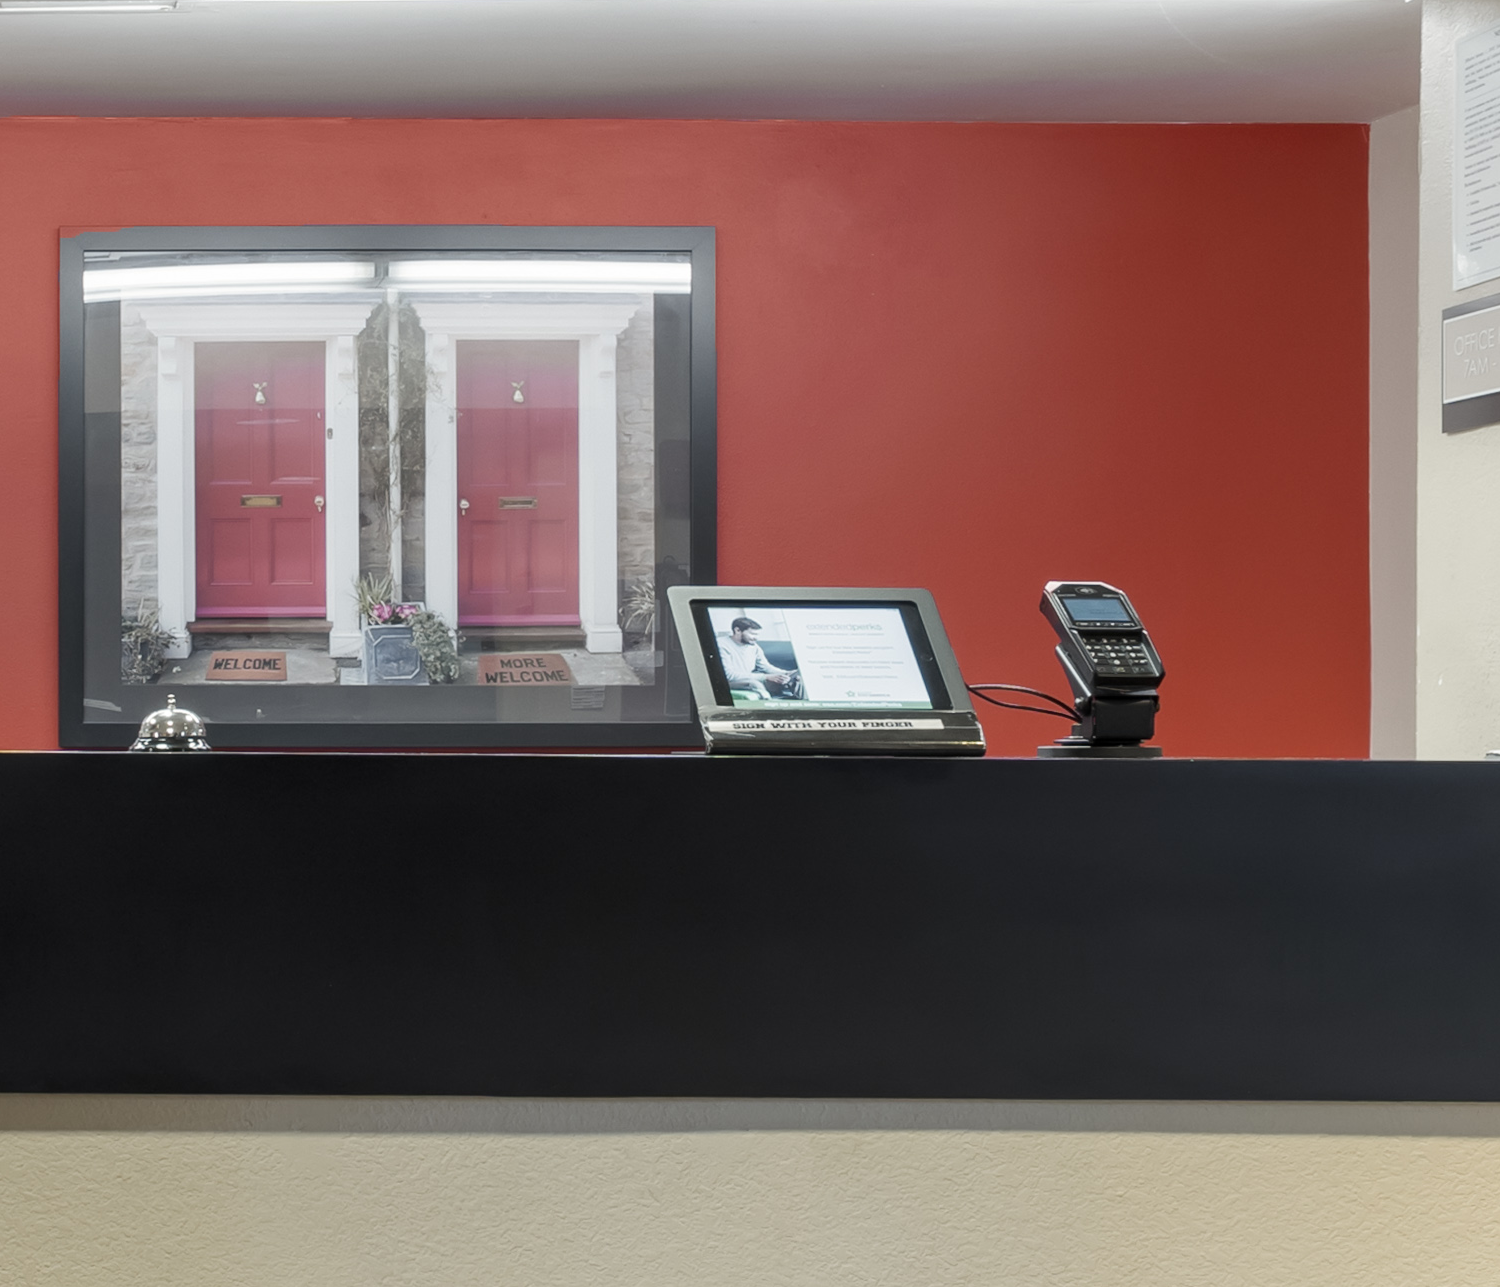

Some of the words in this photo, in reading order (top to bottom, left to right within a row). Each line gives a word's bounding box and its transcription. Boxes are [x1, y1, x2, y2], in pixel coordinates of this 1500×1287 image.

[1454, 328, 1495, 356] OFFICE
[1463, 357, 1489, 379] 7AM
[213, 658, 281, 670] WELCOME
[500, 658, 546, 668] MORE
[485, 670, 569, 684] WELCOME
